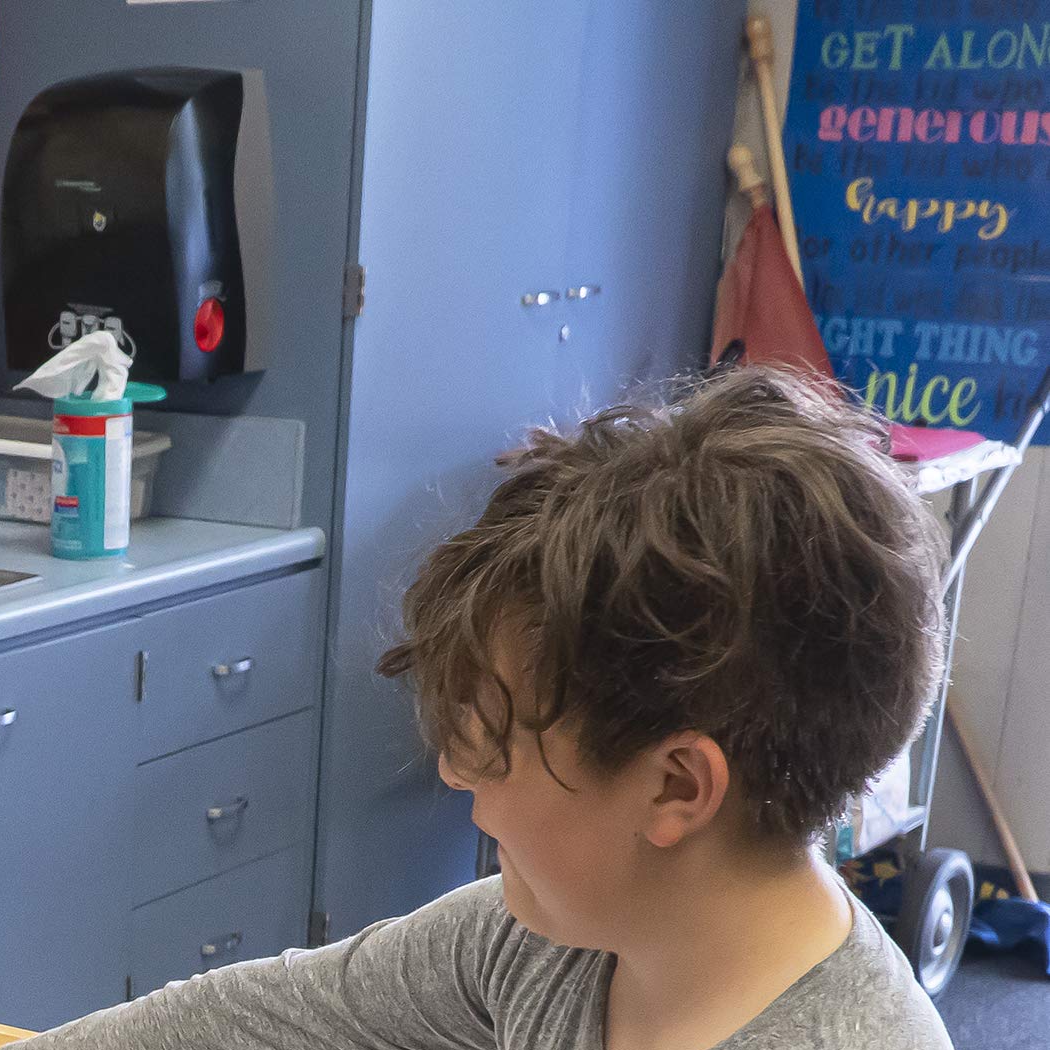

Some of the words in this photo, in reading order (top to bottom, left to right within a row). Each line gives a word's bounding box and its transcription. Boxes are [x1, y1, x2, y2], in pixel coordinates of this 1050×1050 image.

[821, 23, 915, 71] GET
[924, 22, 1050, 71] ALON
[846, 176, 1018, 240] happy
[914, 320, 1039, 366] THING
[864, 362, 983, 427] nice
